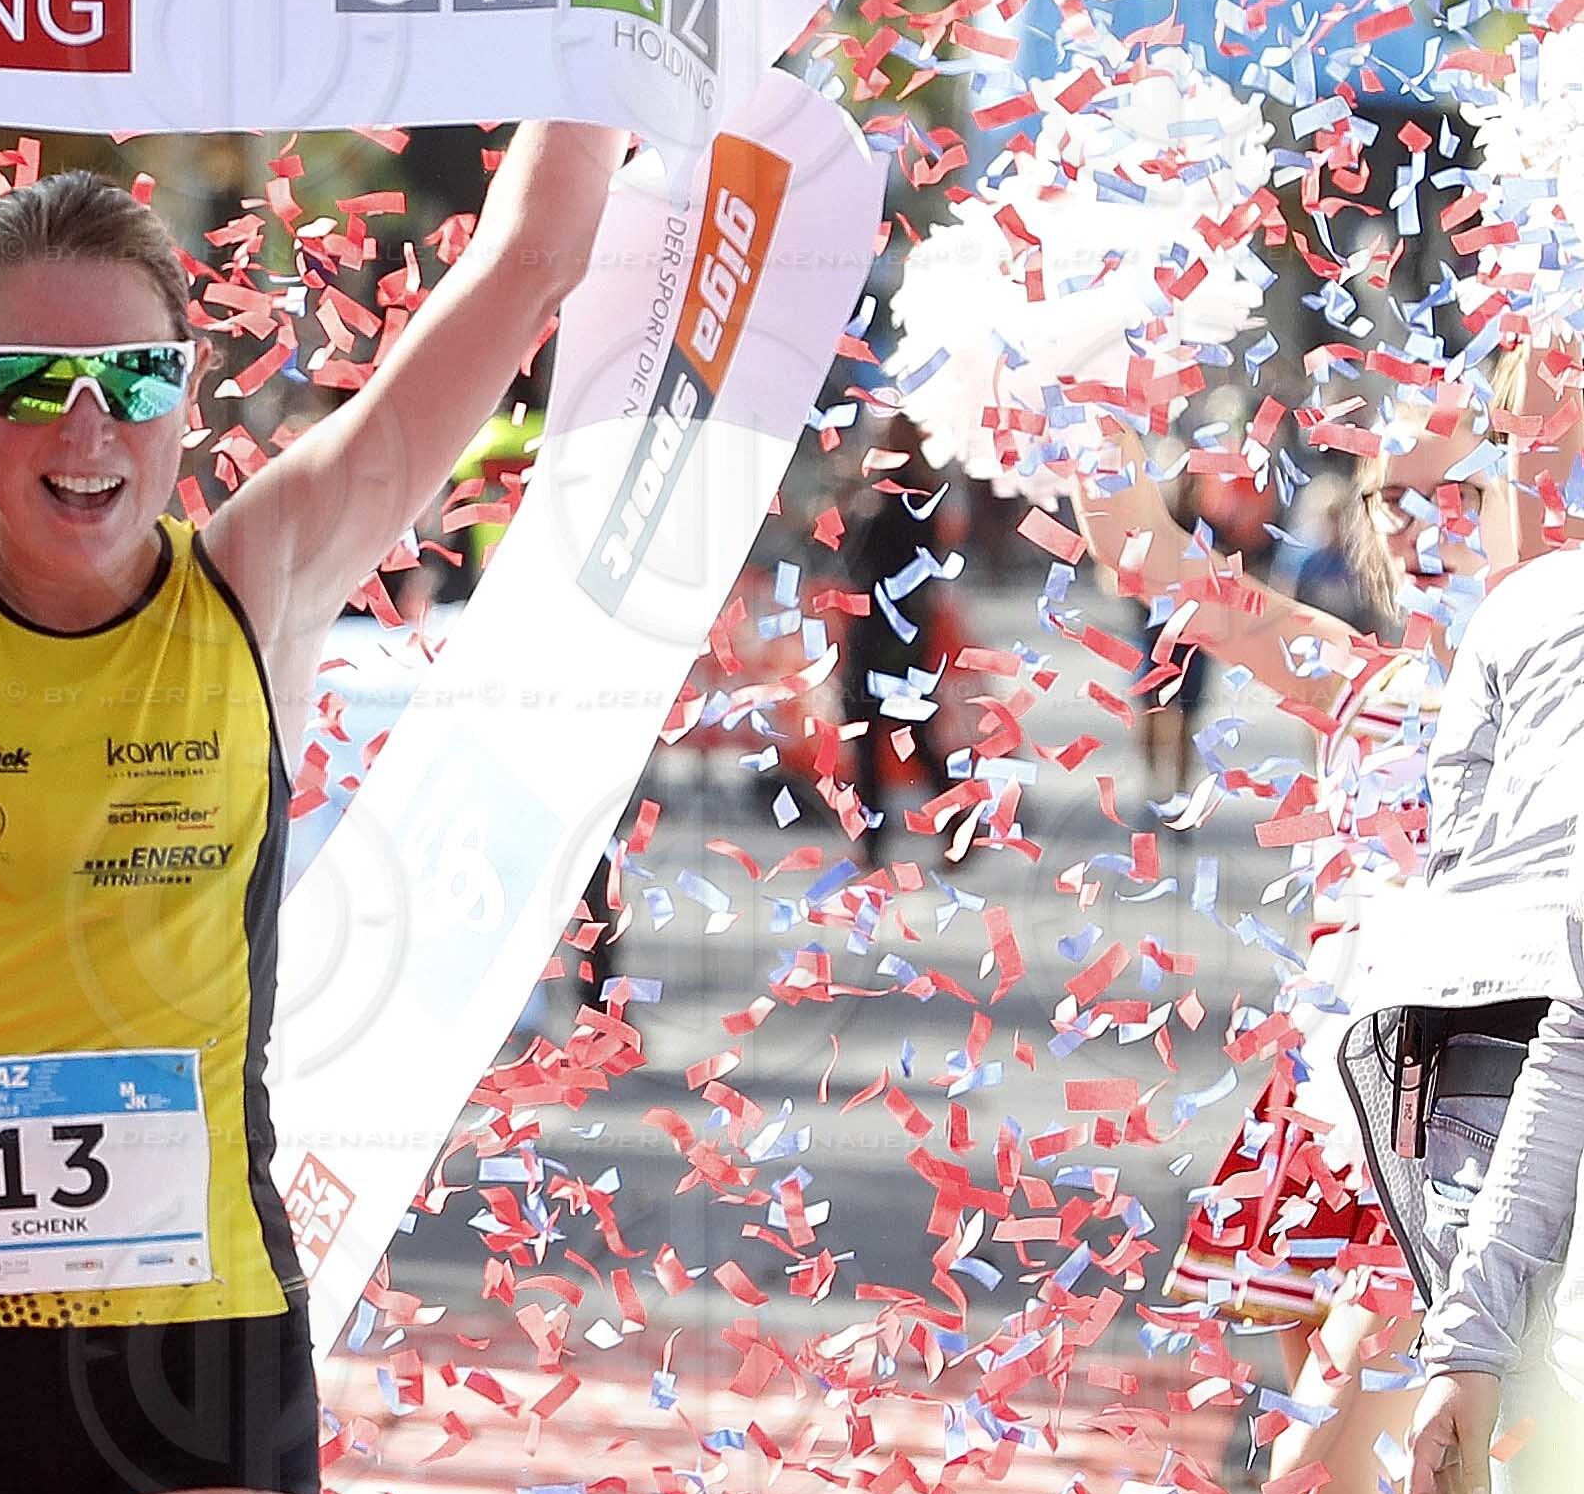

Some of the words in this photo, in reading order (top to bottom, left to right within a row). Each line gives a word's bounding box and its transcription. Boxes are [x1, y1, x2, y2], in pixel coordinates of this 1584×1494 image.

[615, 19, 715, 110] HOLDING
[689, 189, 759, 364] giga
[645, 268, 677, 354] SPORT
[106, 731, 220, 766] konrad
[130, 844, 234, 868] ENERGY
[11, 1216, 89, 1237] SCHENK
